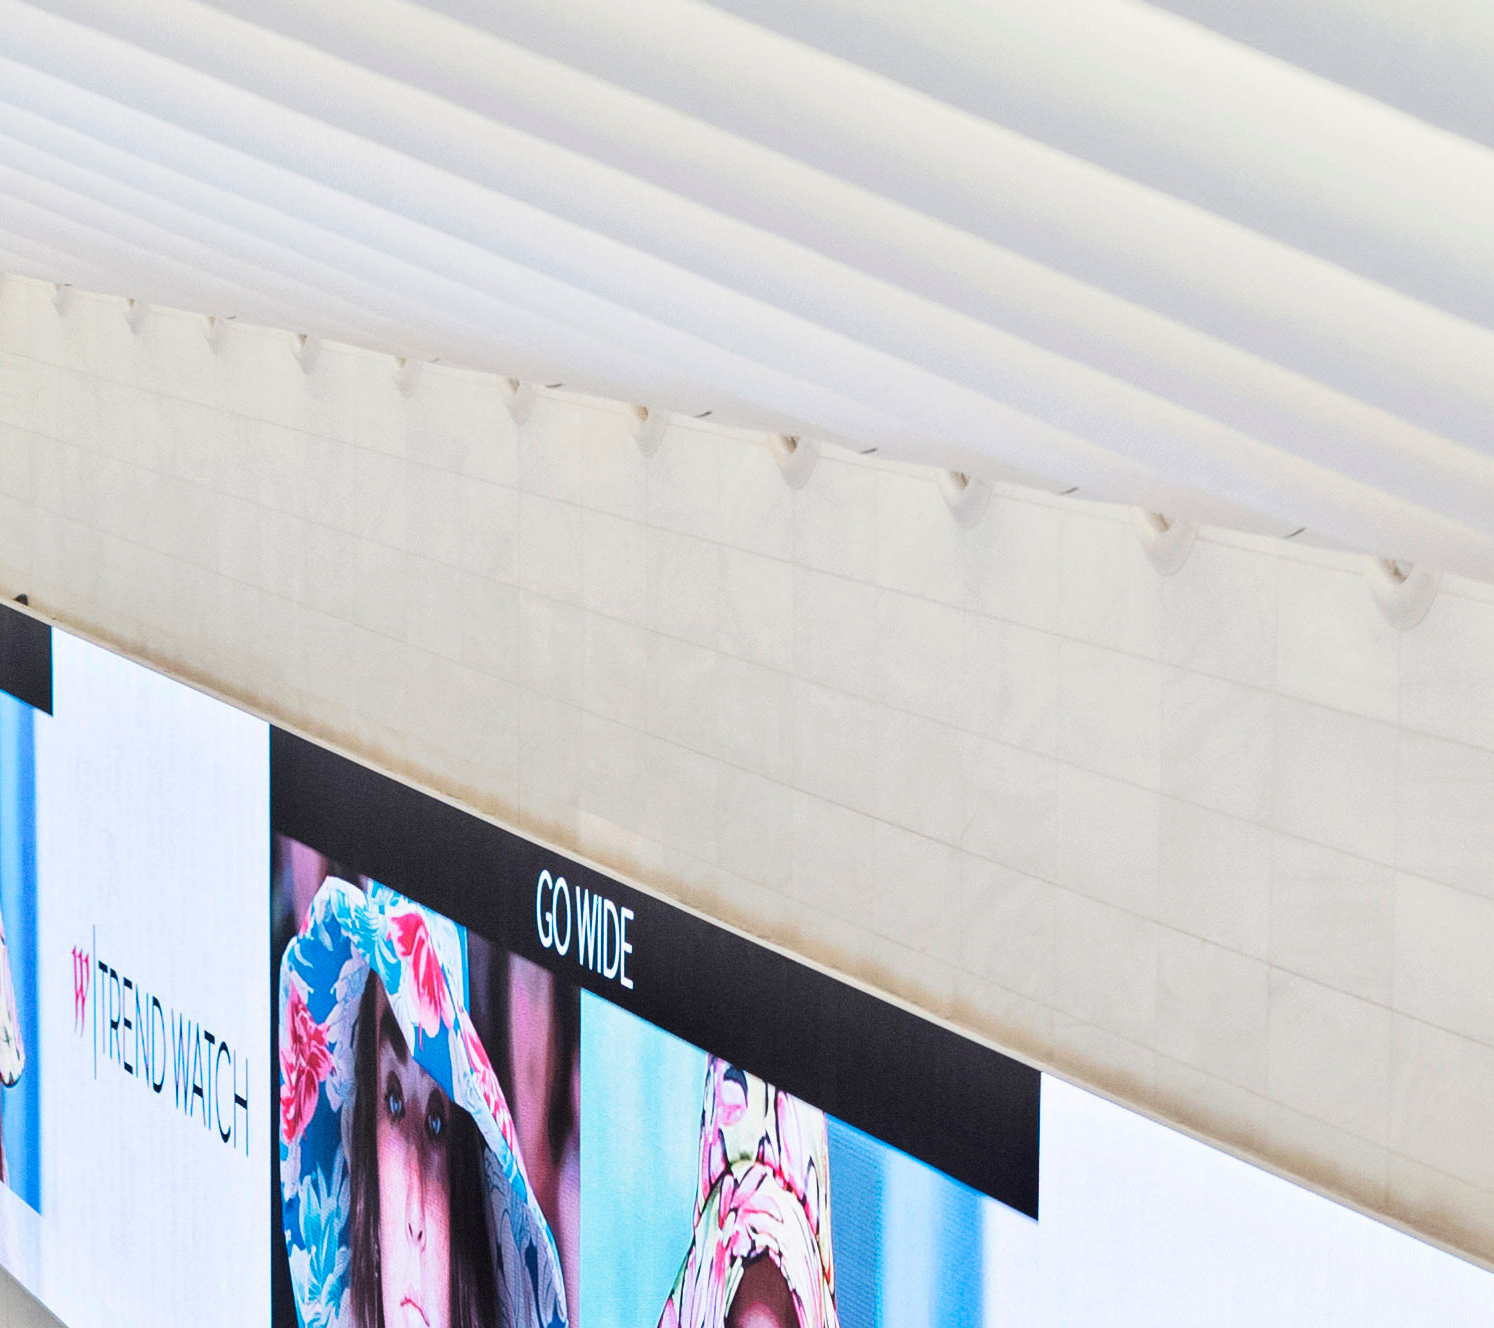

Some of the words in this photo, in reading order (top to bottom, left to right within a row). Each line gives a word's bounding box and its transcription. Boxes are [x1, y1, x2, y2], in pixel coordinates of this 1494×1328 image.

[536, 869, 572, 956] GO
[575, 885, 635, 990] WIDE
[98, 960, 167, 1094] TREND
[170, 1007, 249, 1158] WATCH
